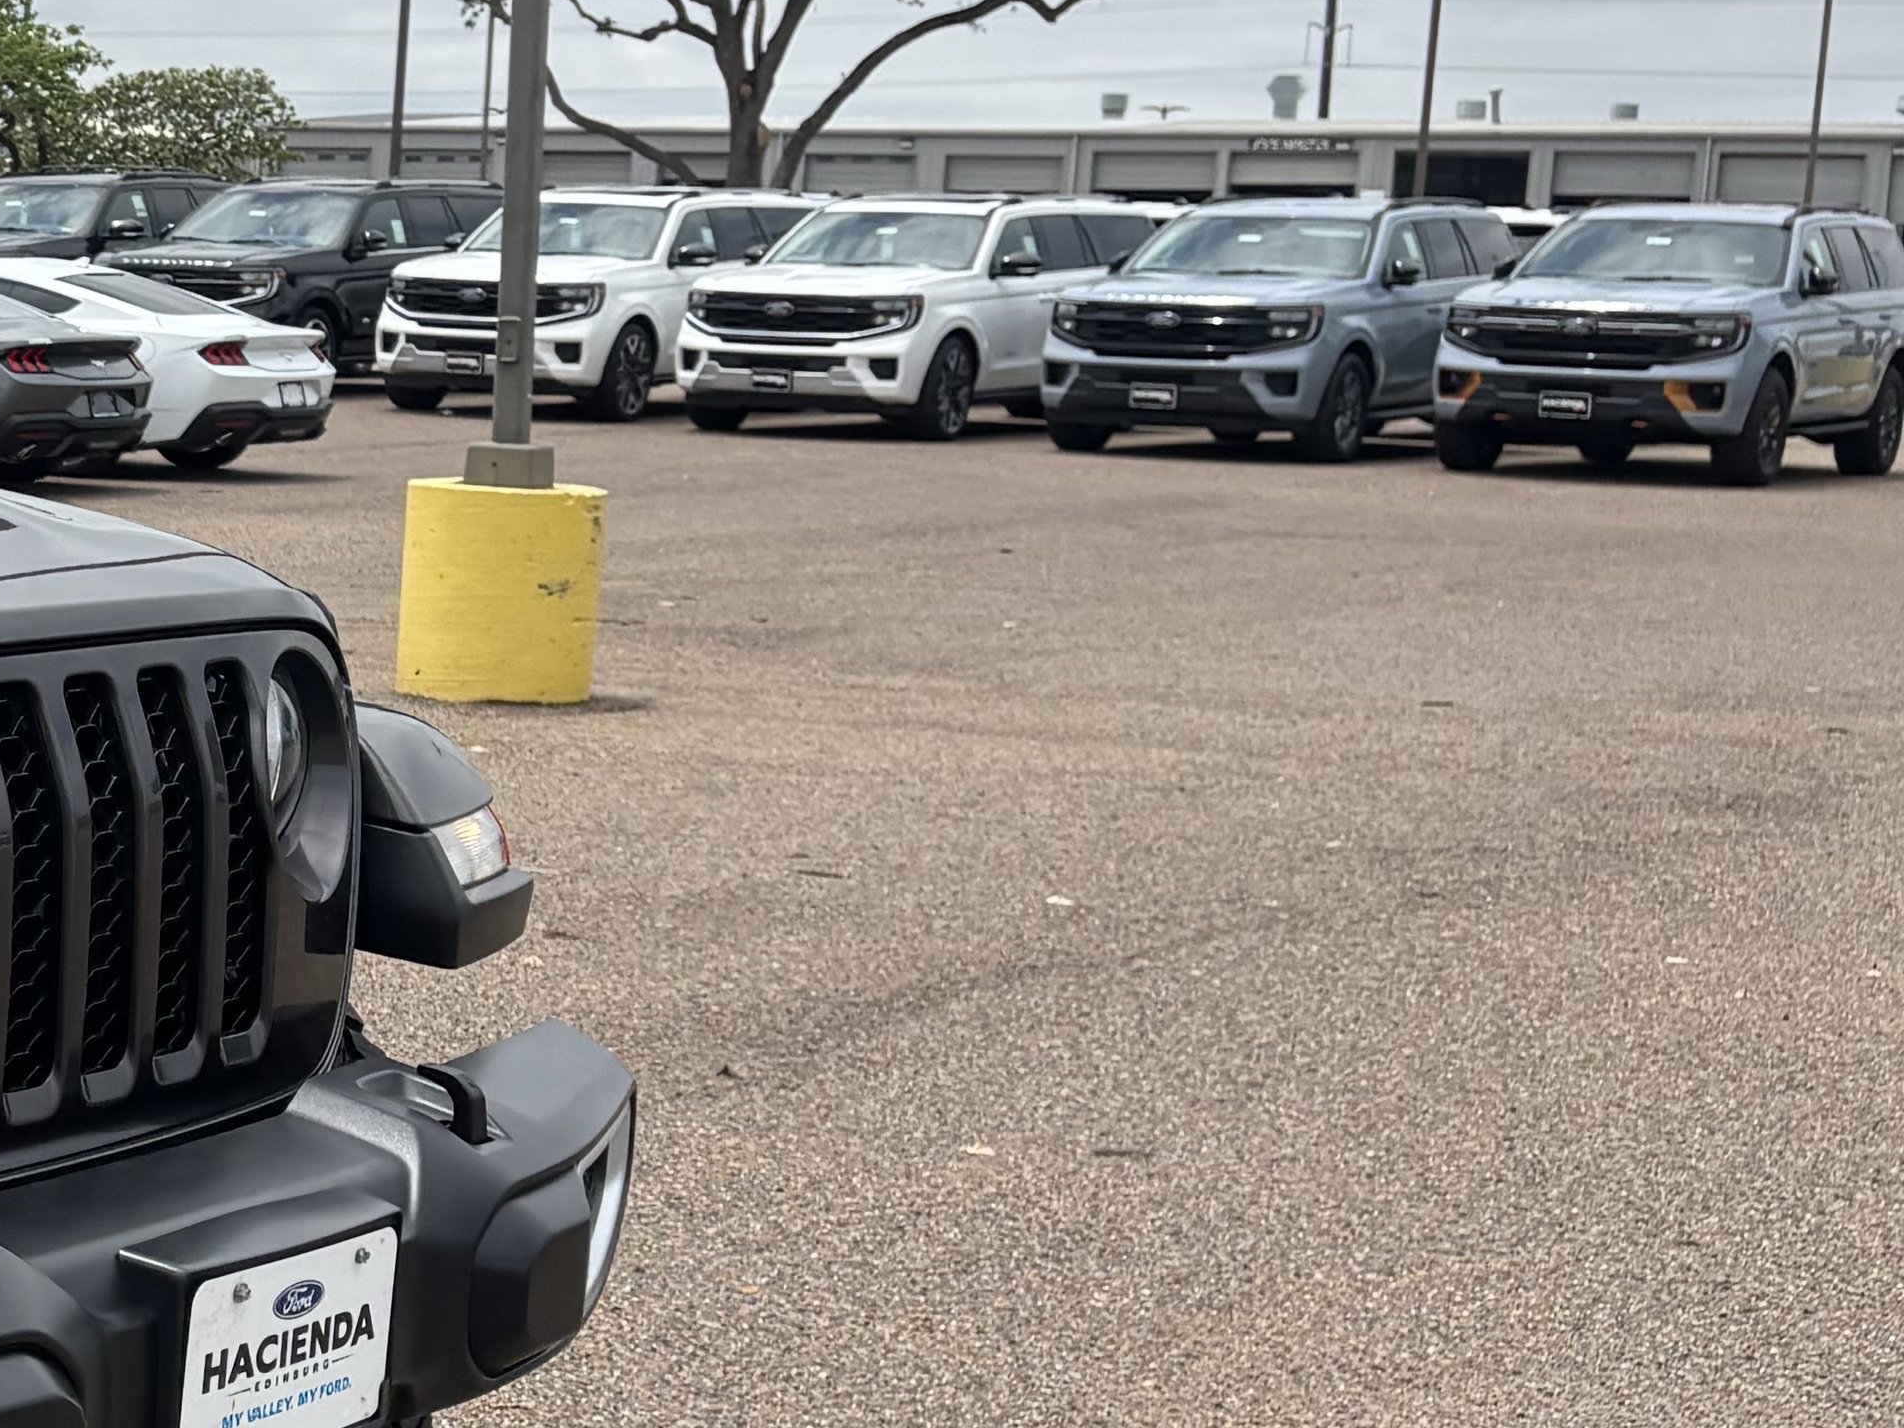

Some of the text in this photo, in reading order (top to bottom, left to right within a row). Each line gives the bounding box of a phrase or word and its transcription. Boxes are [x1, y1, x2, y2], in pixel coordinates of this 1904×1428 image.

[201, 1303, 375, 1395] HACIENDA
[254, 1358, 330, 1393] EDINBURG
[297, 1387, 318, 1407] MY
[319, 1376, 352, 1400] FORD.
